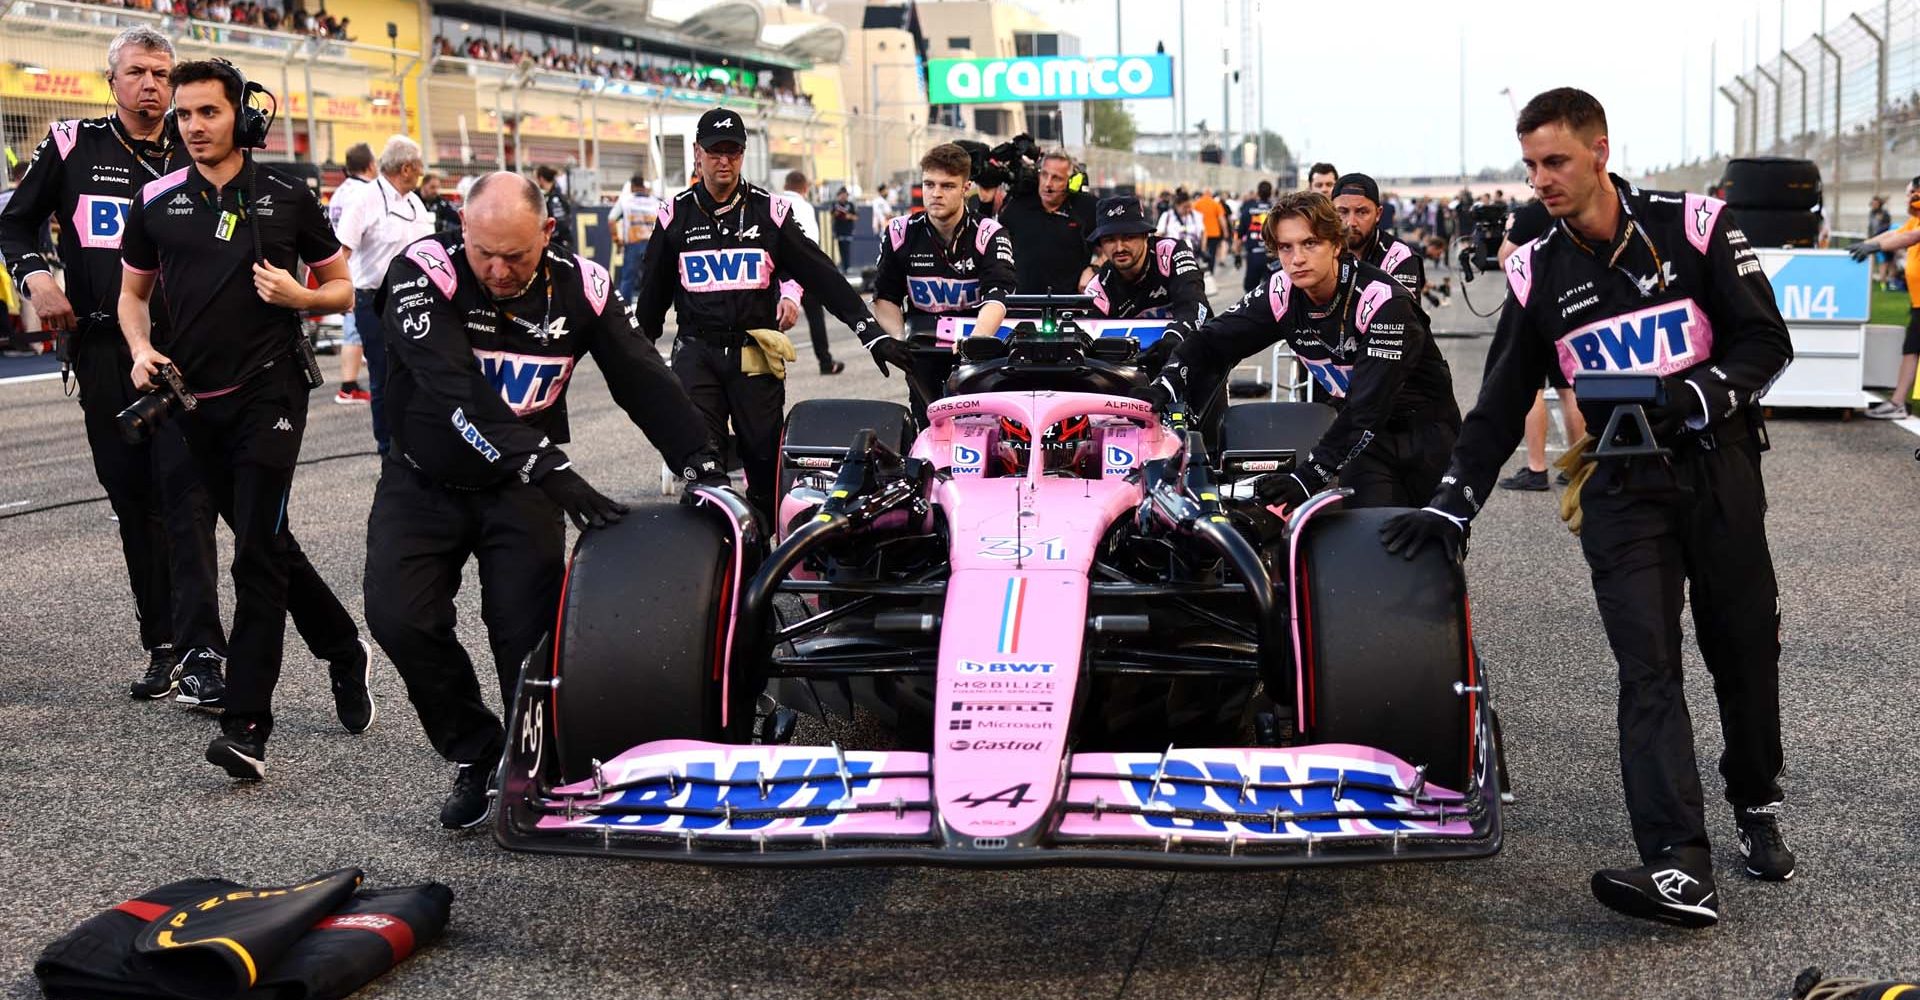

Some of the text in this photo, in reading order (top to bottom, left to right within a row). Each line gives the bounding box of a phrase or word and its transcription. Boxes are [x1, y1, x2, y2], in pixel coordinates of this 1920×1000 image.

[946, 58, 1153, 98] aramco
[92, 165, 129, 174] ALPINE
[100, 175, 129, 184] BINANCE
[175, 207, 194, 215] BWT
[684, 252, 762, 284] BWT
[910, 279, 982, 305] BWT
[1784, 285, 1839, 319] N4
[1566, 295, 1600, 314] BINANCE
[403, 311, 431, 339] plug
[1570, 308, 1689, 371] BWT
[1368, 347, 1403, 360] PIRELLI
[462, 423, 500, 462] BWT
[805, 458, 830, 467] Castrol
[1251, 461, 1277, 471] Castrol
[977, 537, 1066, 561] 31
[989, 663, 1054, 673] BWT
[521, 696, 544, 778] plug
[977, 721, 1053, 730] Microsoft
[973, 740, 1043, 751] Castrol
[583, 755, 880, 830] BWT
[1125, 760, 1418, 834] BWT
